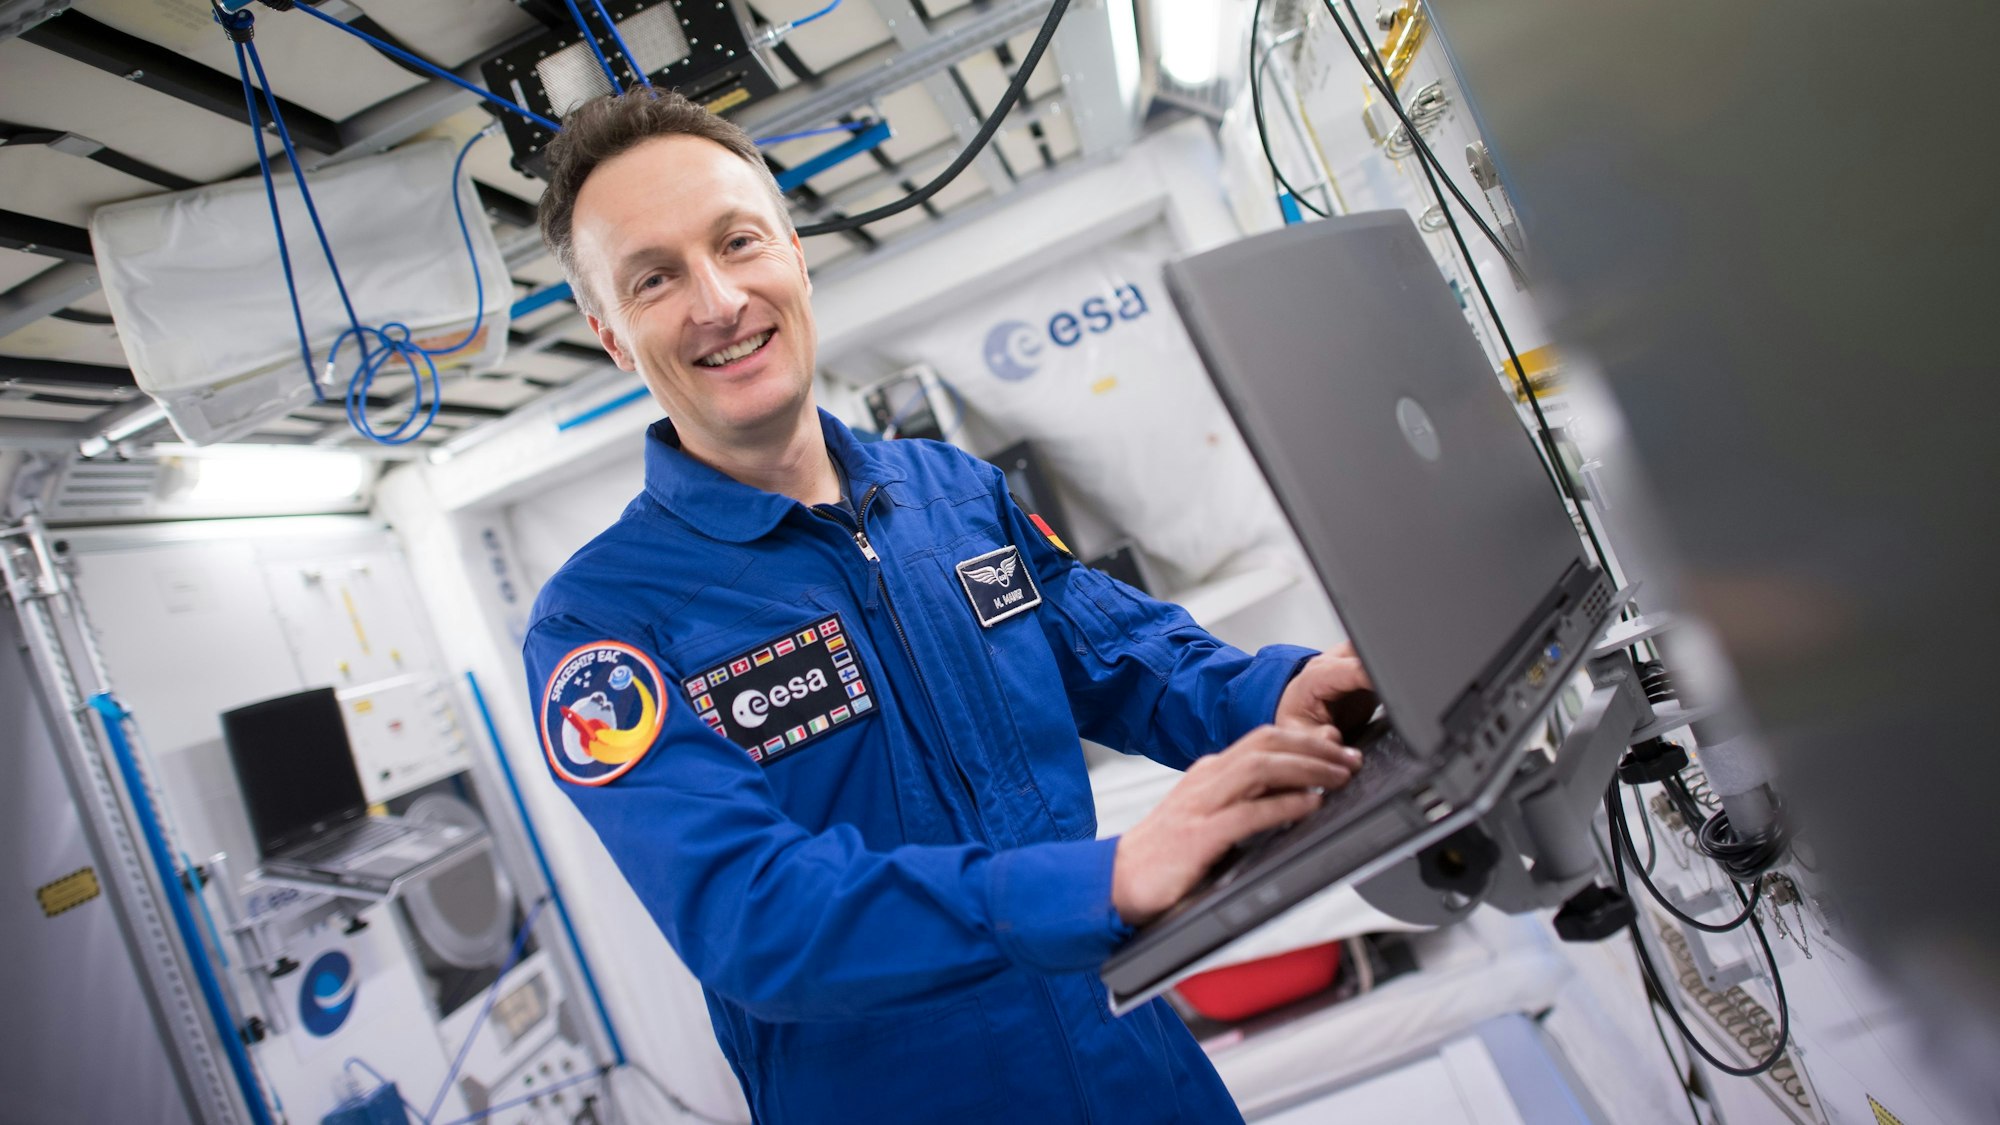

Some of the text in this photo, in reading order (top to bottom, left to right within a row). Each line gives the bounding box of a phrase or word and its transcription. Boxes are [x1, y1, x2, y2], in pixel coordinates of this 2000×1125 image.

[1049, 284, 1149, 347] esa
[551, 651, 621, 702] SPACESHIP EAC
[769, 668, 828, 707] esa
